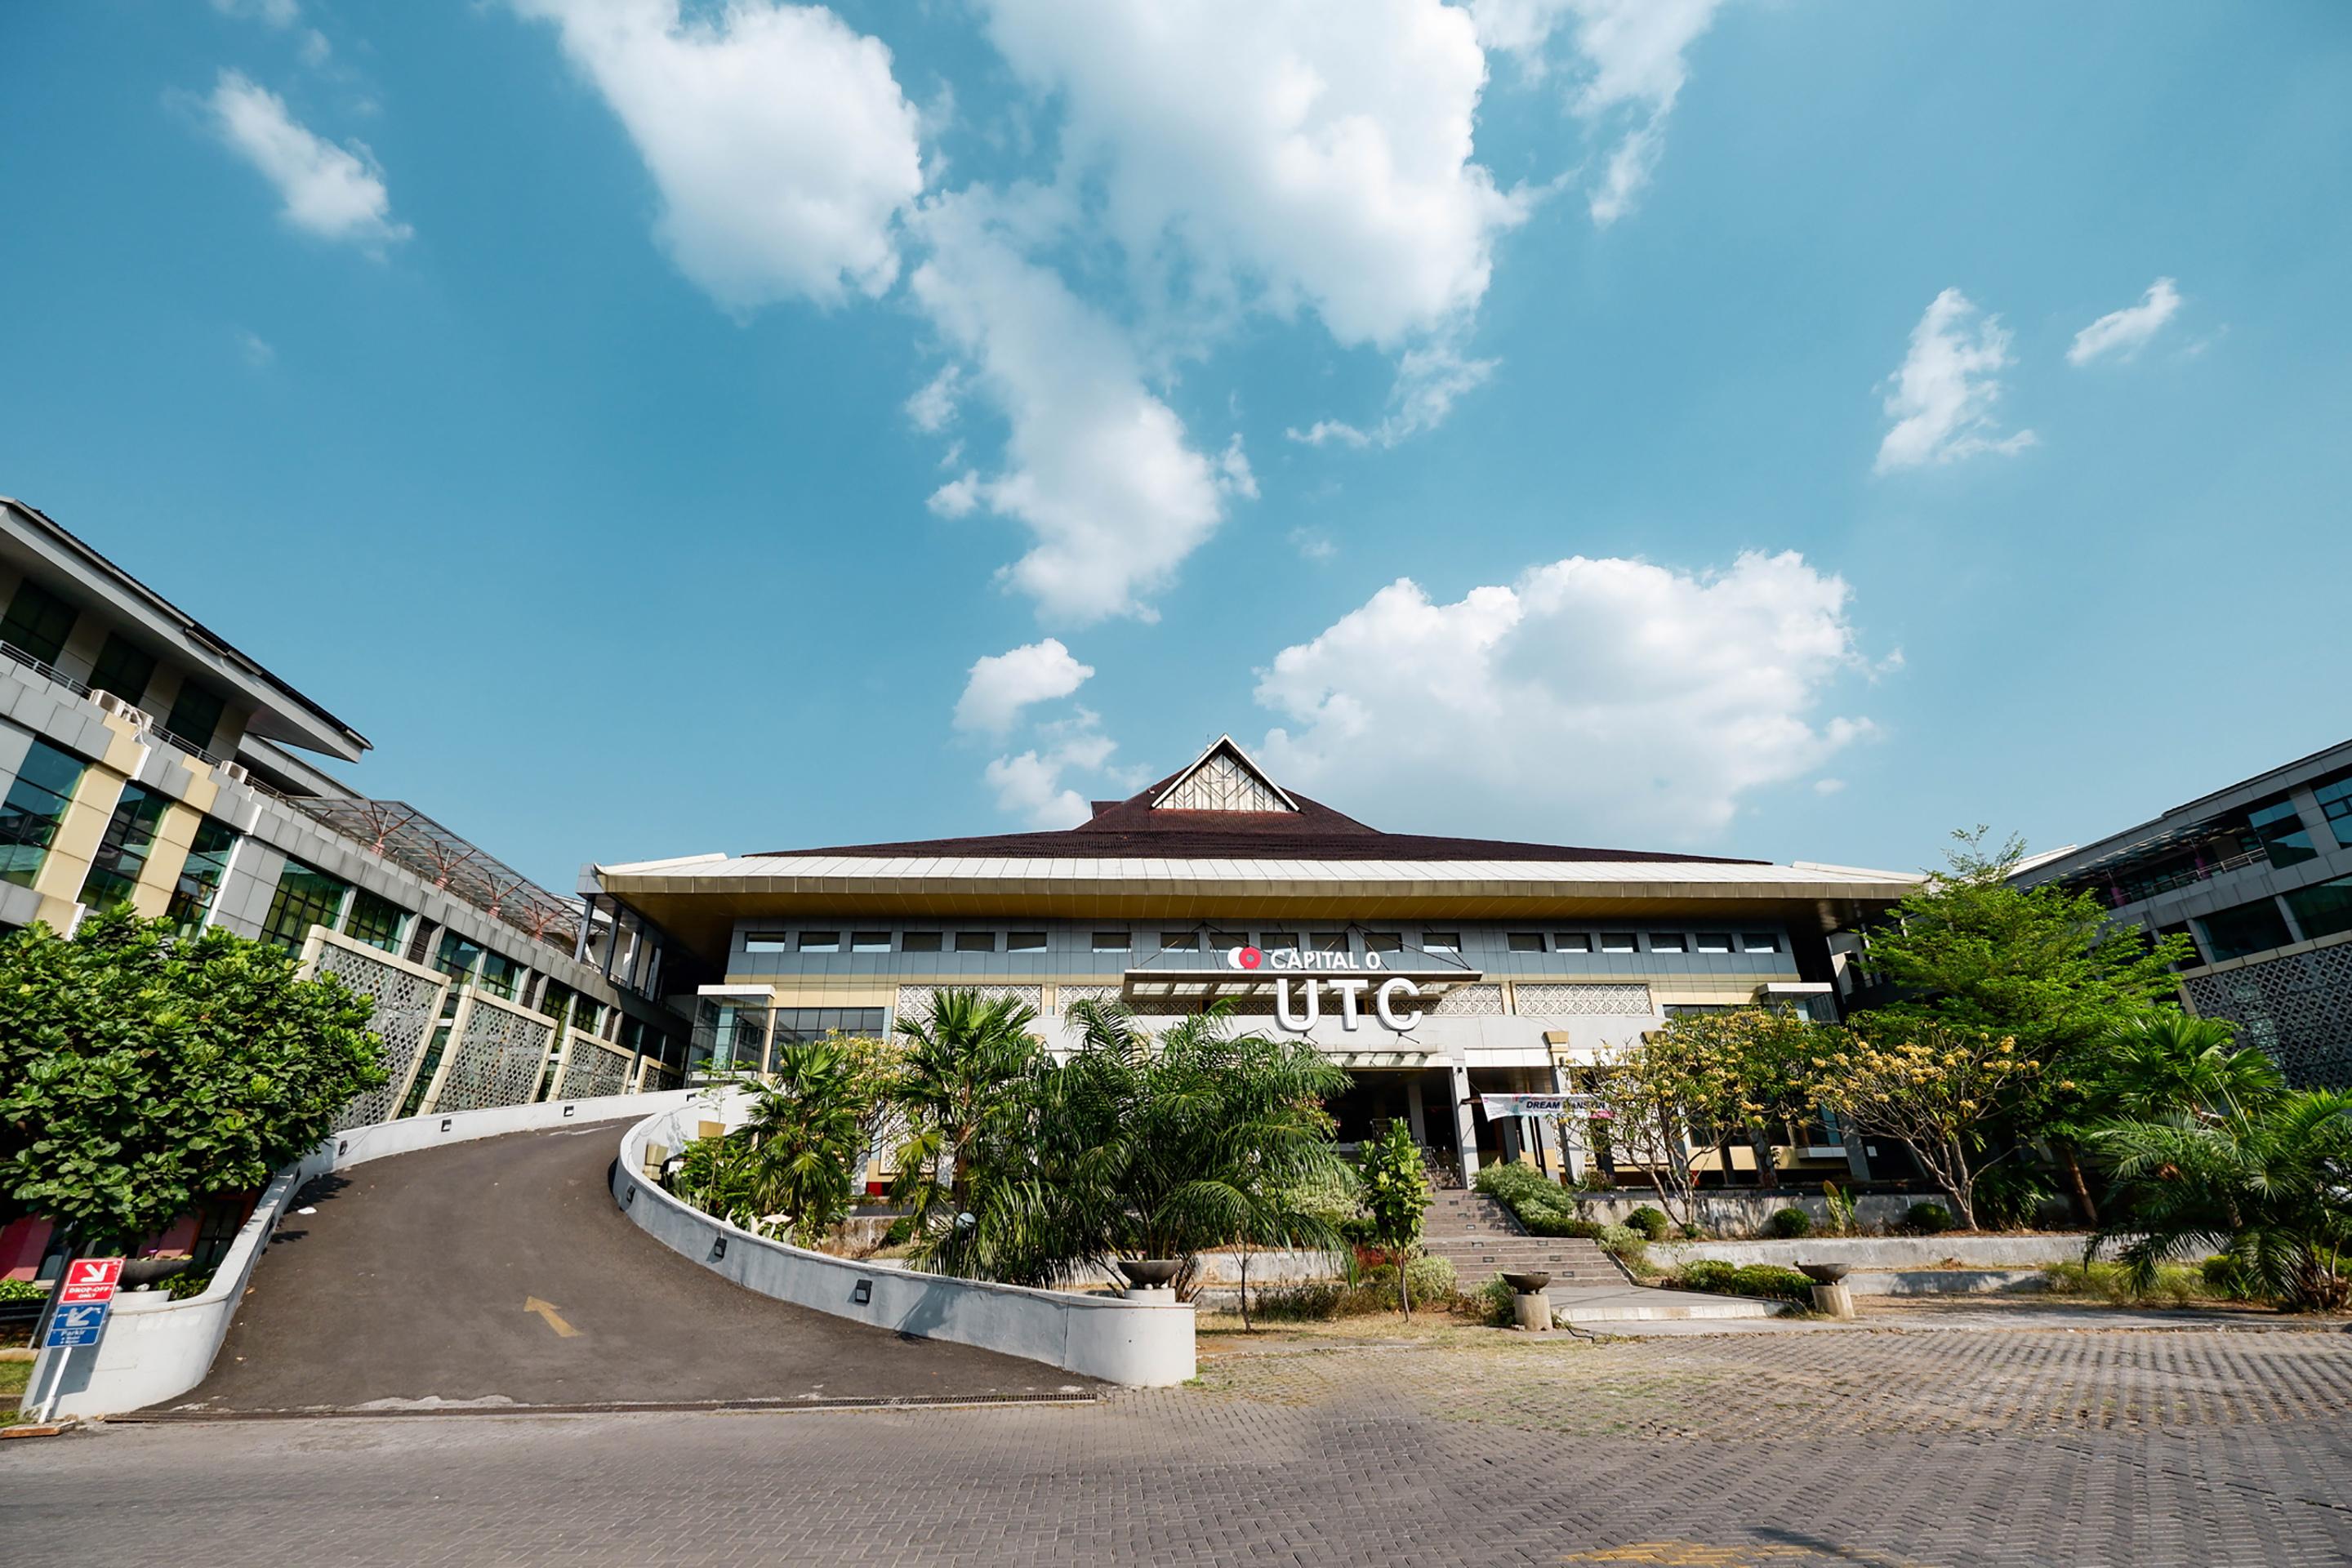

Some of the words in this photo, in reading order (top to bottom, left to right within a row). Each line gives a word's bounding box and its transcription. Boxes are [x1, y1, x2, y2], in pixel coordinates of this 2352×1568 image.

[1270, 951, 1360, 969] CAPITAL
[1276, 977, 1423, 1031] UTC
[1526, 1101, 1560, 1109] DREAM
